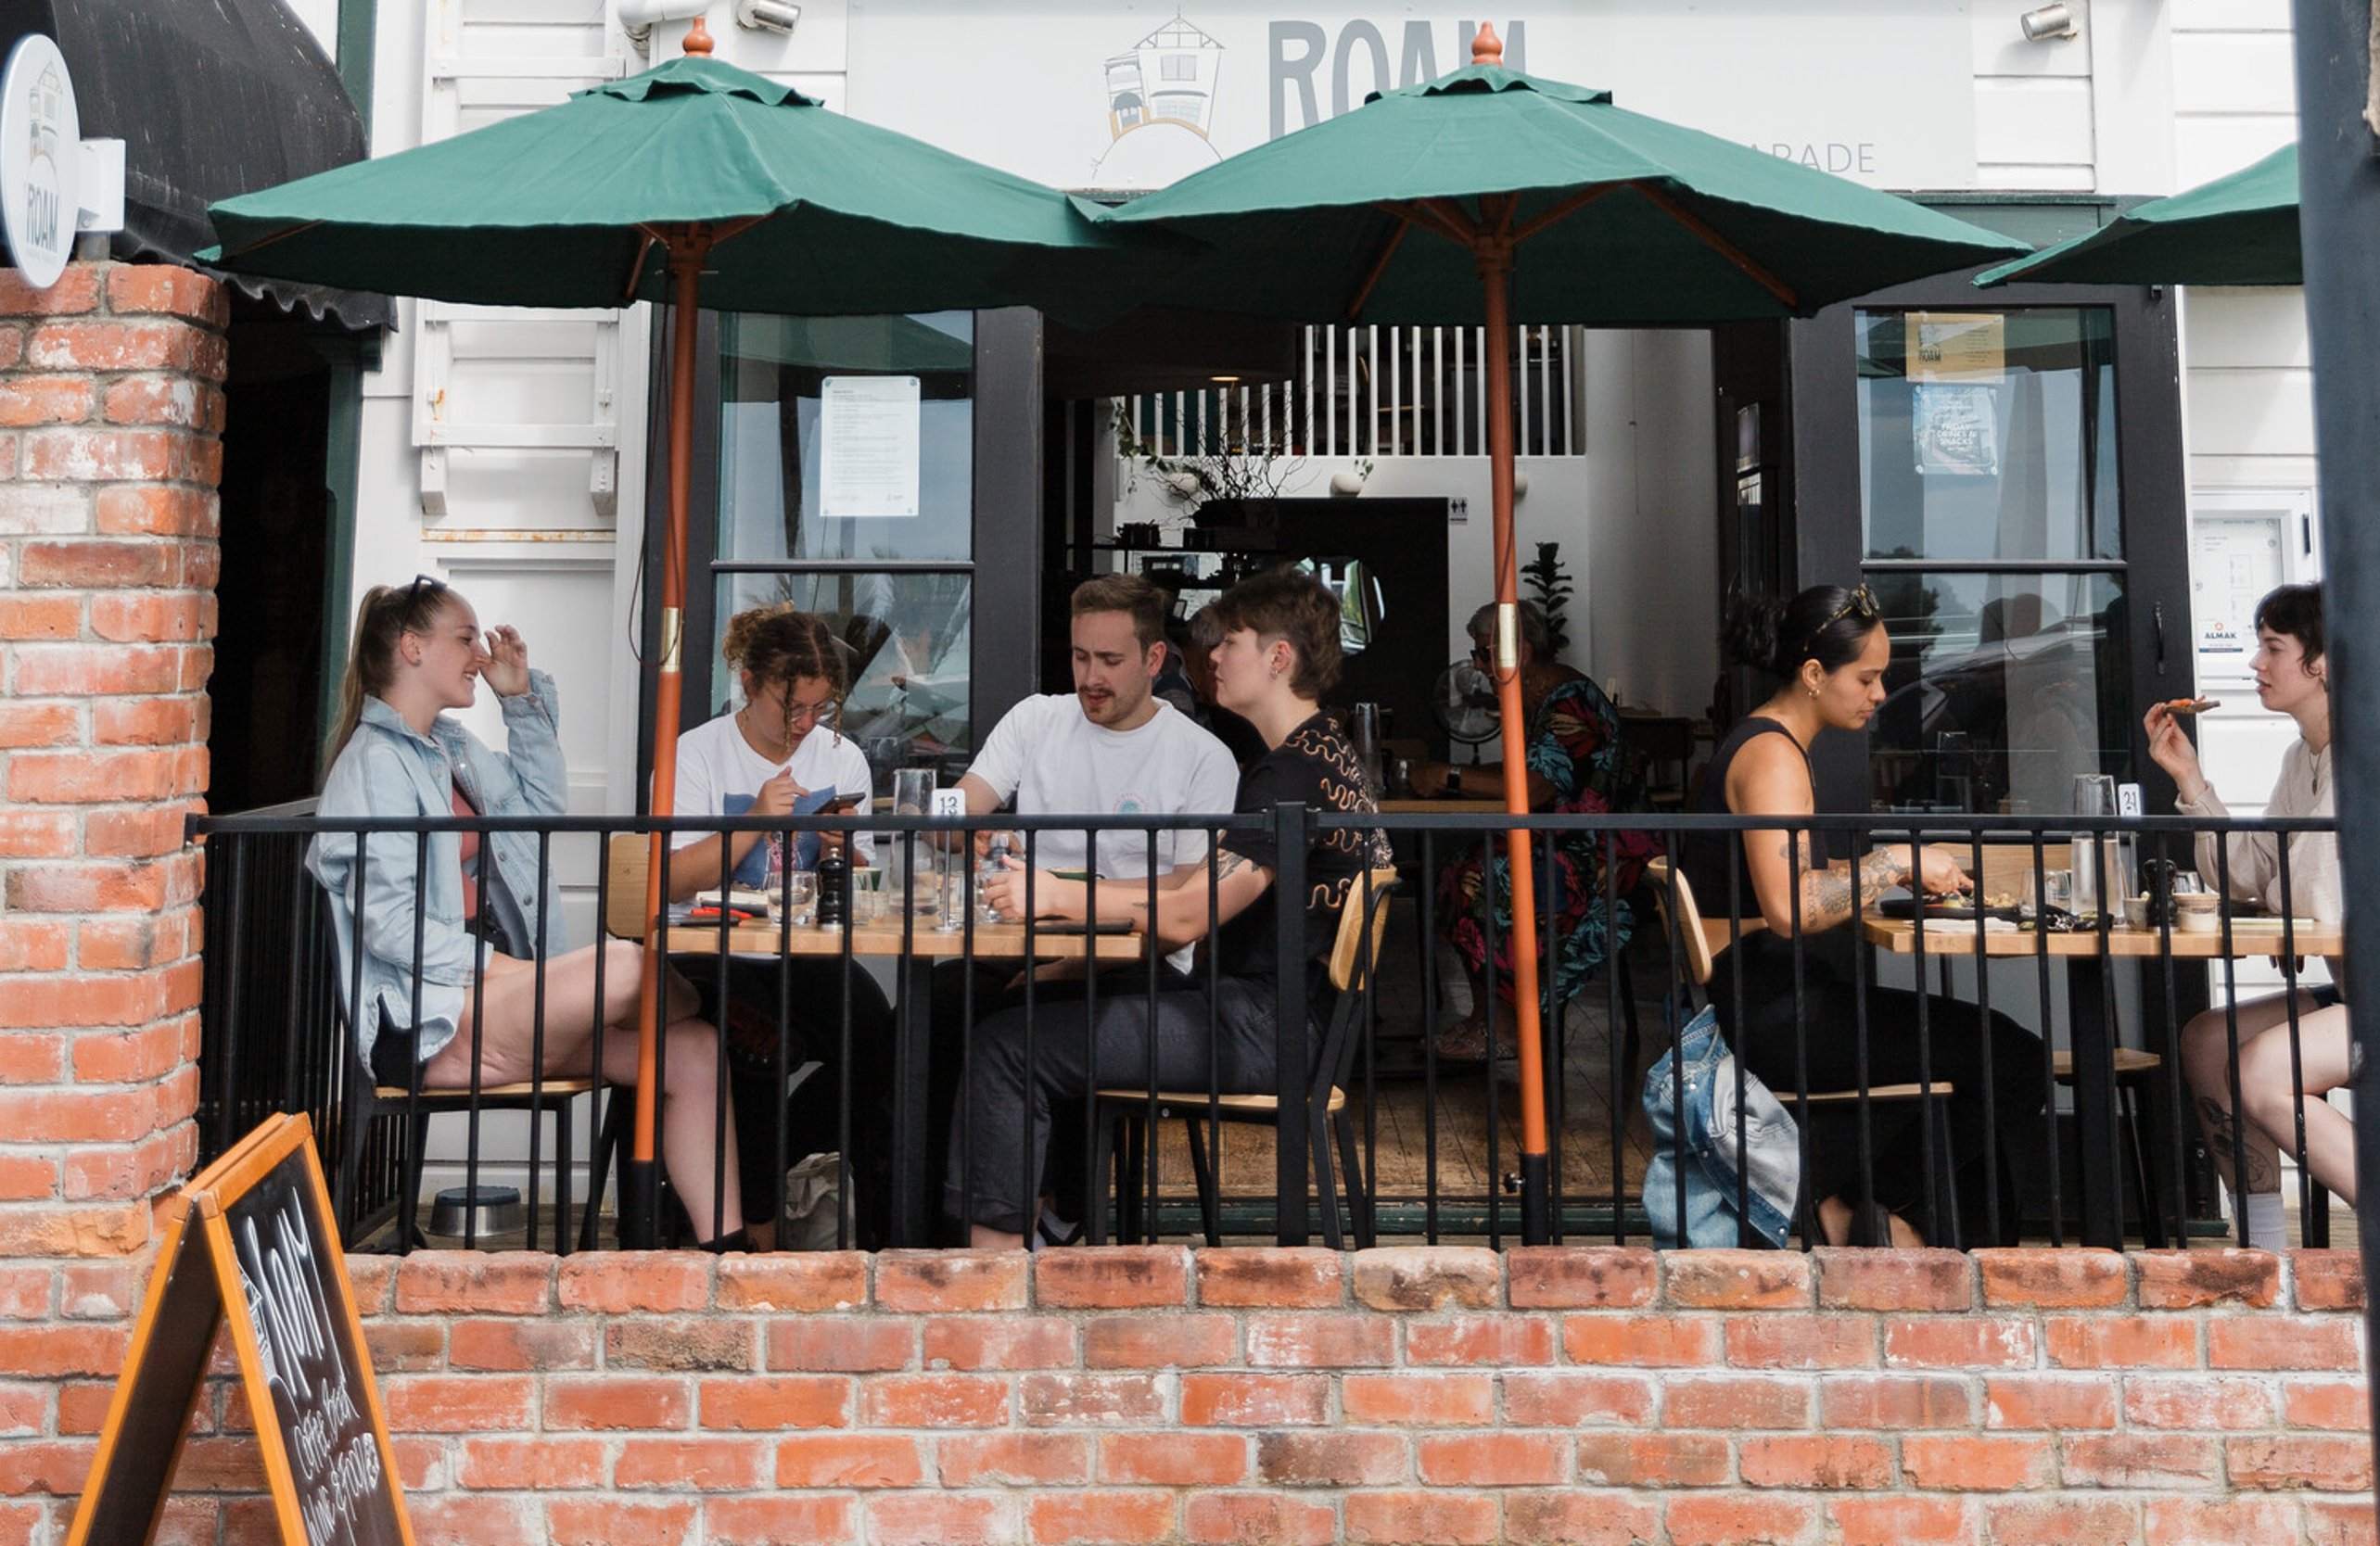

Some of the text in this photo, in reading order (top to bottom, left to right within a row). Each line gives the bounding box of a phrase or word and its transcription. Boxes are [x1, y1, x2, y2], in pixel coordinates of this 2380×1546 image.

[1750, 143, 1876, 173] ADE
[27, 184, 58, 253] ROAM
[247, 1185, 346, 1399] ROAM
